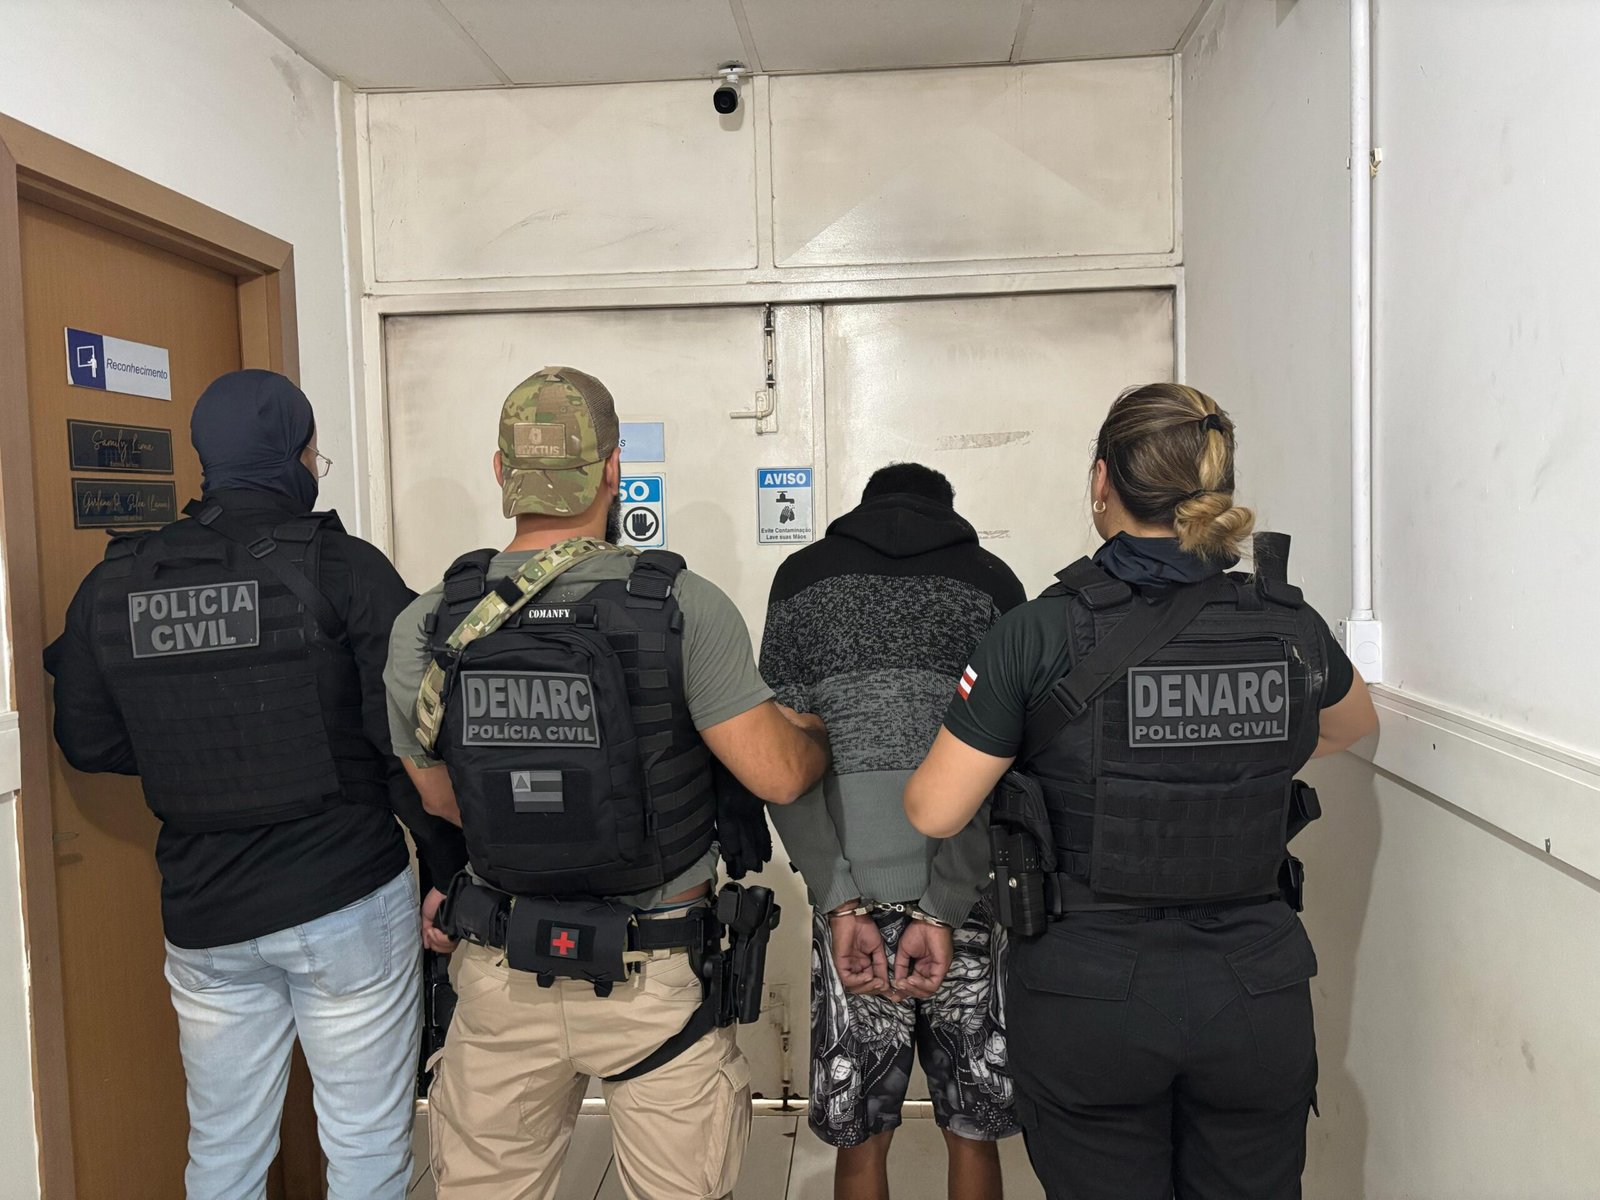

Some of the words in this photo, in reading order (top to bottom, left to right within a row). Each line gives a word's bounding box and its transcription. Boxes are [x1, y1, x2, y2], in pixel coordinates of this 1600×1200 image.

[106, 357, 169, 380] Reconhecimento
[764, 472, 806, 485] AVISO
[150, 619, 237, 652] CIVIL
[467, 677, 591, 722] DENARC
[1134, 669, 1284, 718] DENARC
[467, 721, 542, 741] POLÍCIA
[546, 725, 596, 742] CIVIL
[1135, 721, 1222, 740] POLÍCIA
[1228, 720, 1283, 737] CIVIL
